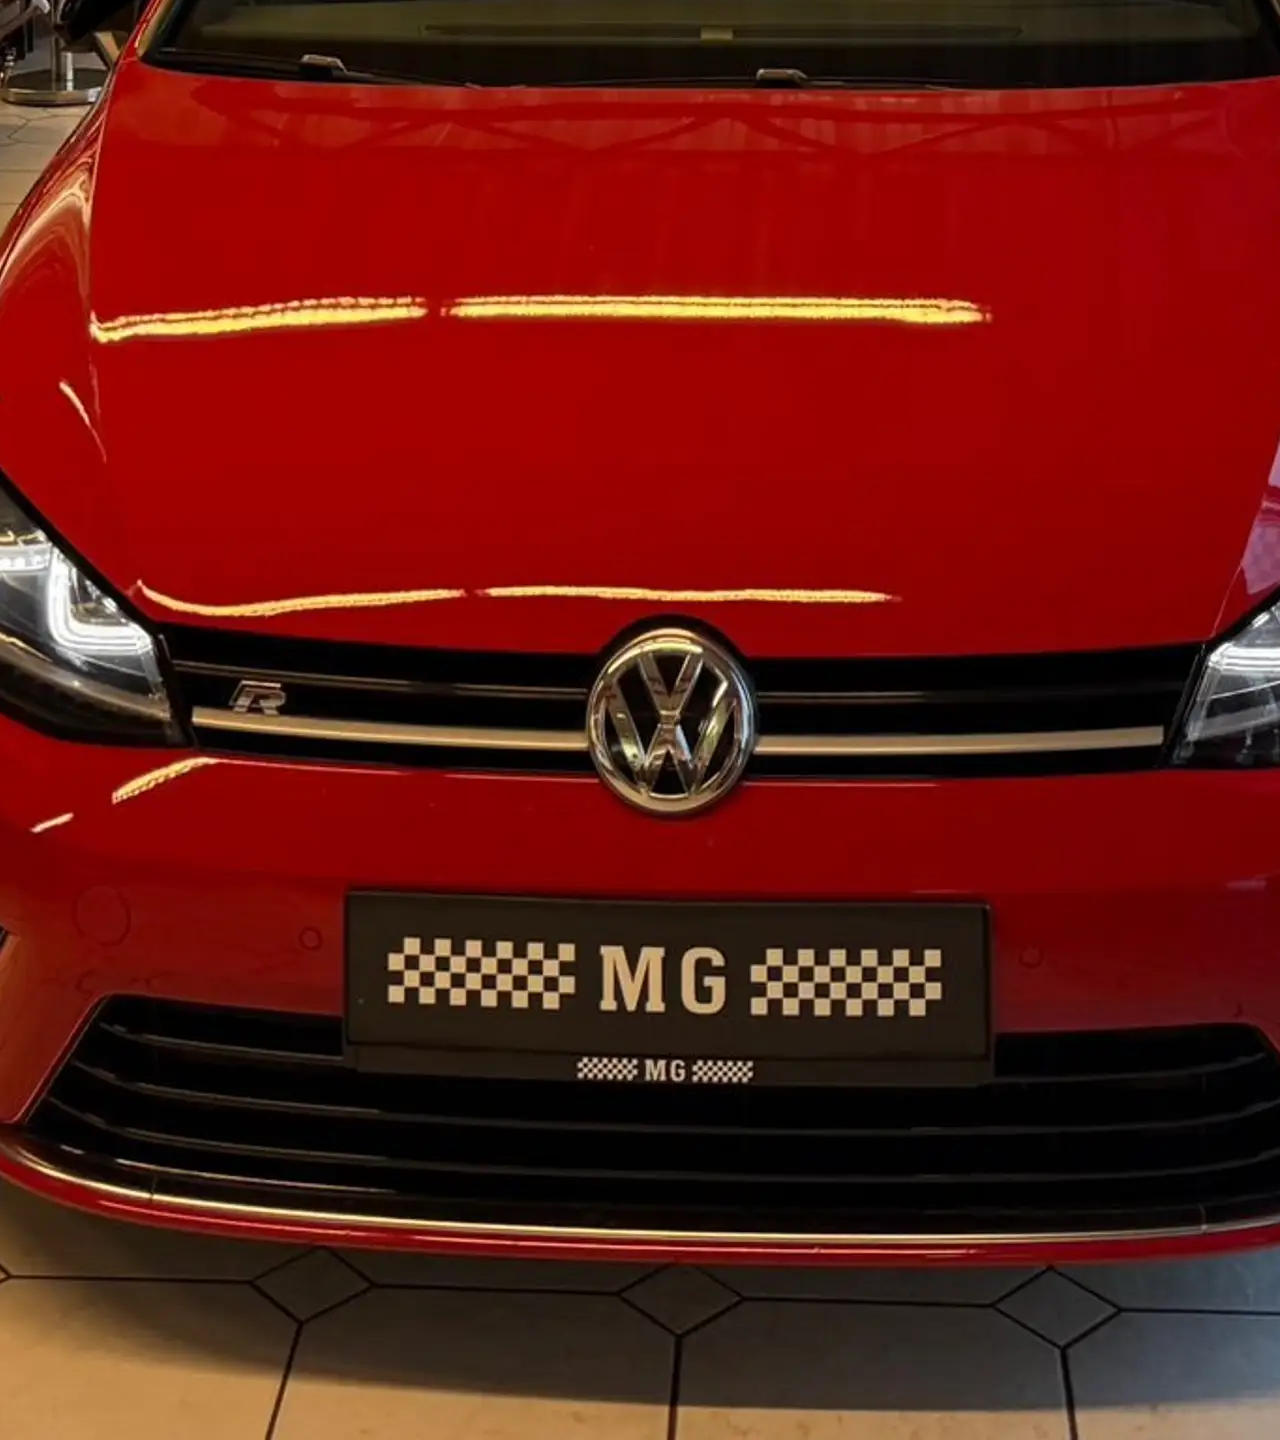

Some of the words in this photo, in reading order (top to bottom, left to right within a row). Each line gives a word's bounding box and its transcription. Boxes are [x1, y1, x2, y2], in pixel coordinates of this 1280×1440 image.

[227, 679, 287, 716] R
[599, 944, 727, 1015] MG
[644, 1059, 687, 1083] MG
